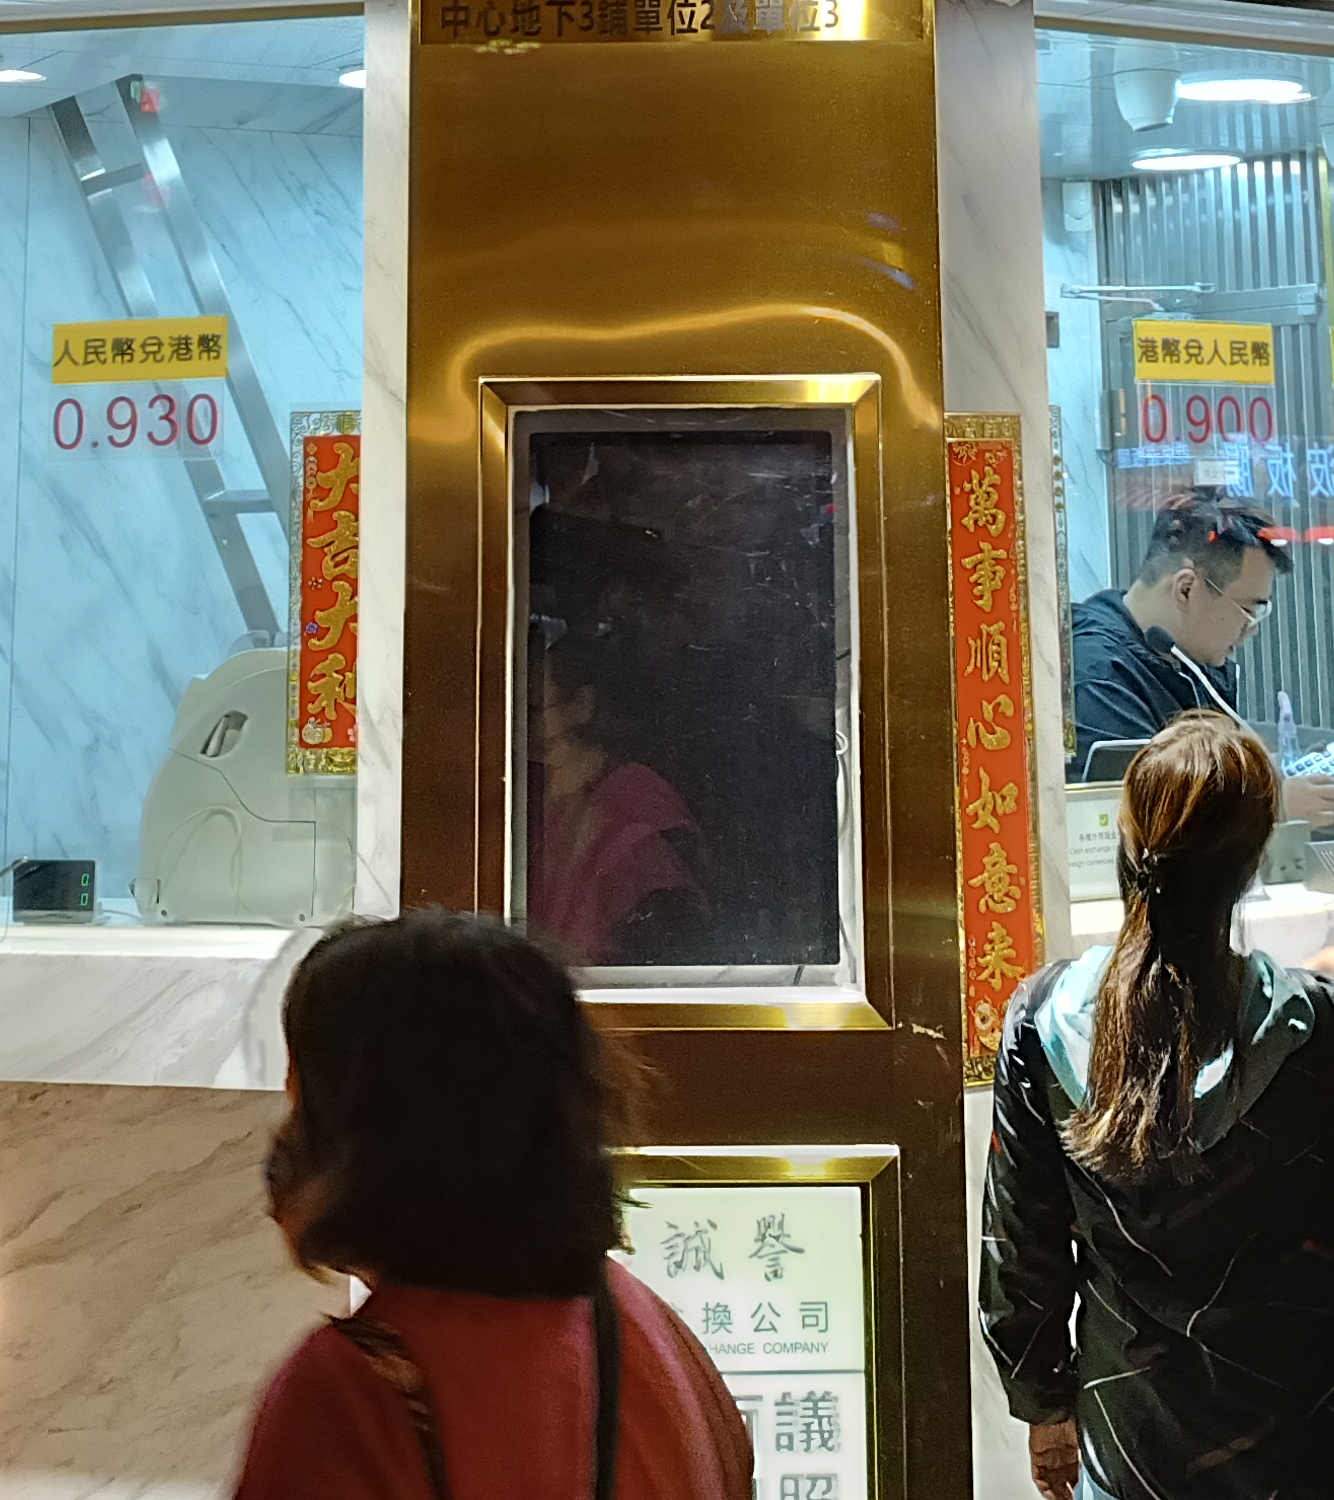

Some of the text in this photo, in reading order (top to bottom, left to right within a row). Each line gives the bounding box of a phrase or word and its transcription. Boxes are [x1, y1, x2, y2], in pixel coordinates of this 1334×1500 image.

[53, 393, 220, 451] 0.930
[1142, 393, 1274, 444] 0.900
[660, 1212, 806, 1282] 誠譽
[671, 1300, 829, 1335] 換公司
[706, 1341, 829, 1355] HANGE COMPANY
